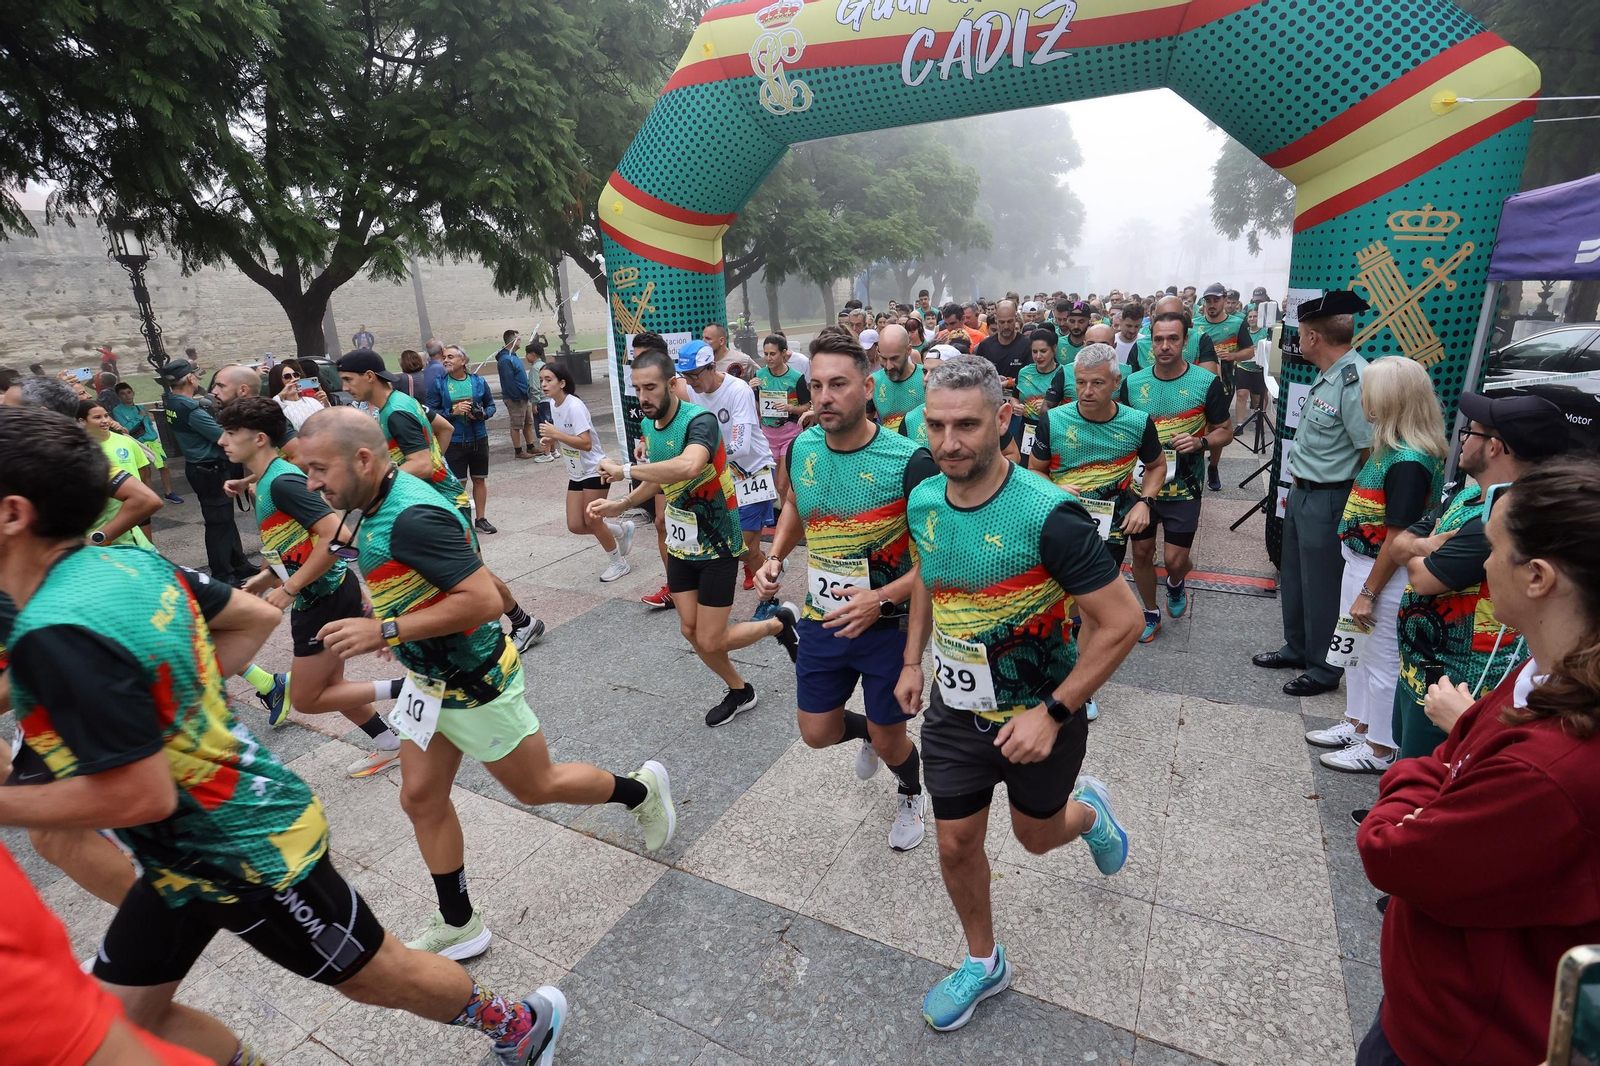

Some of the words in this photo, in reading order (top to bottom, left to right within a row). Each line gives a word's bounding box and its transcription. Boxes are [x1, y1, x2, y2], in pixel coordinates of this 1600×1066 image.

[902, 0, 1077, 87] CÁDIZ
[1565, 413, 1592, 425] Motor
[742, 479, 768, 496] 144
[671, 524, 686, 542] 20
[943, 638, 979, 653] SOLIDARIA
[934, 655, 976, 692] 239
[406, 693, 425, 722] 10
